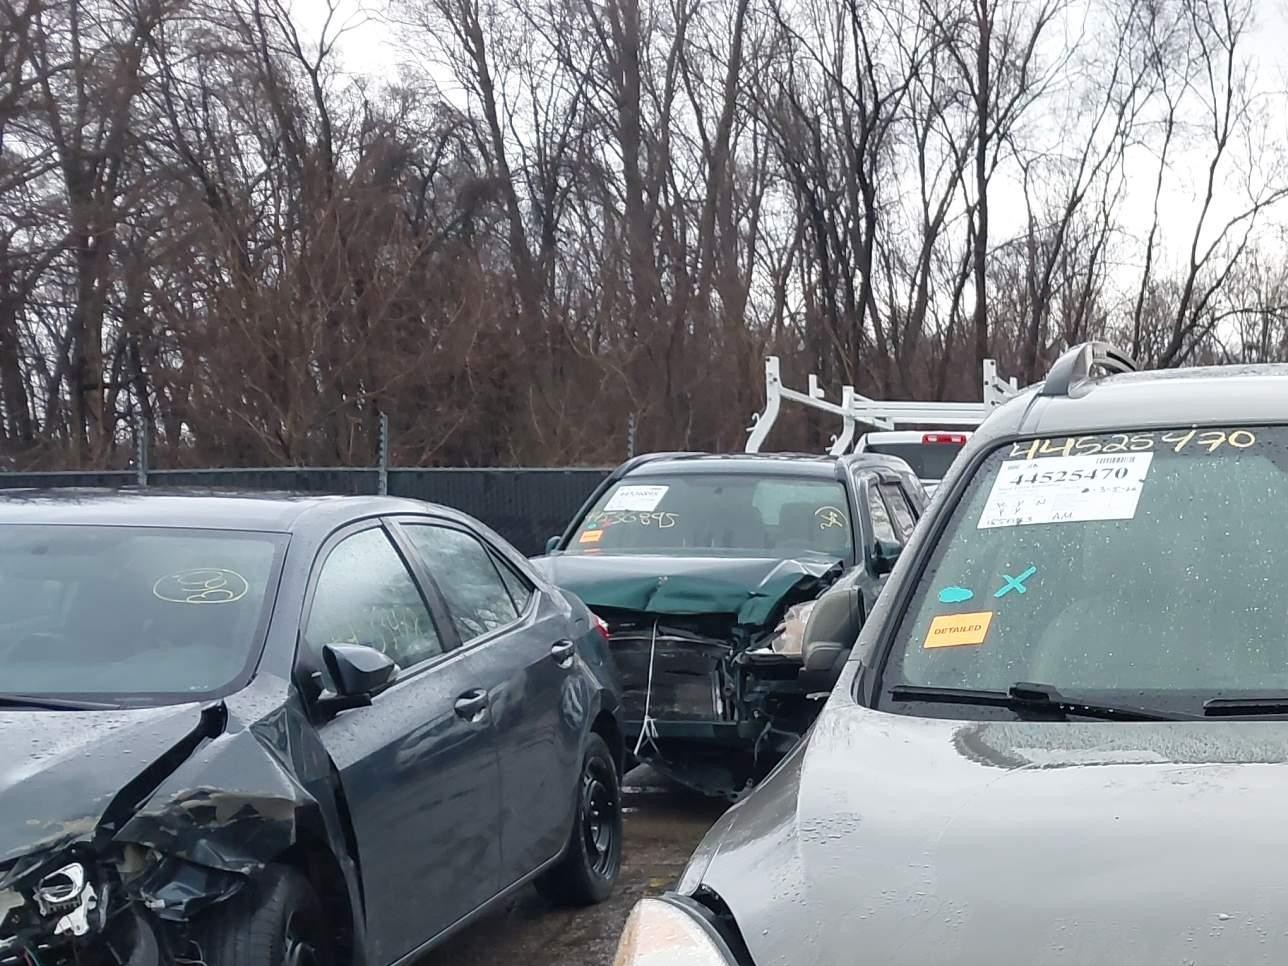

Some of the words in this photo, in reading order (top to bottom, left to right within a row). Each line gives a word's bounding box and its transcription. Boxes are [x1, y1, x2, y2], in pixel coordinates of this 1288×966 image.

[1009, 429, 1256, 460] 44525470
[1009, 467, 1128, 485] 44525470
[934, 624, 982, 636] DETAILED
